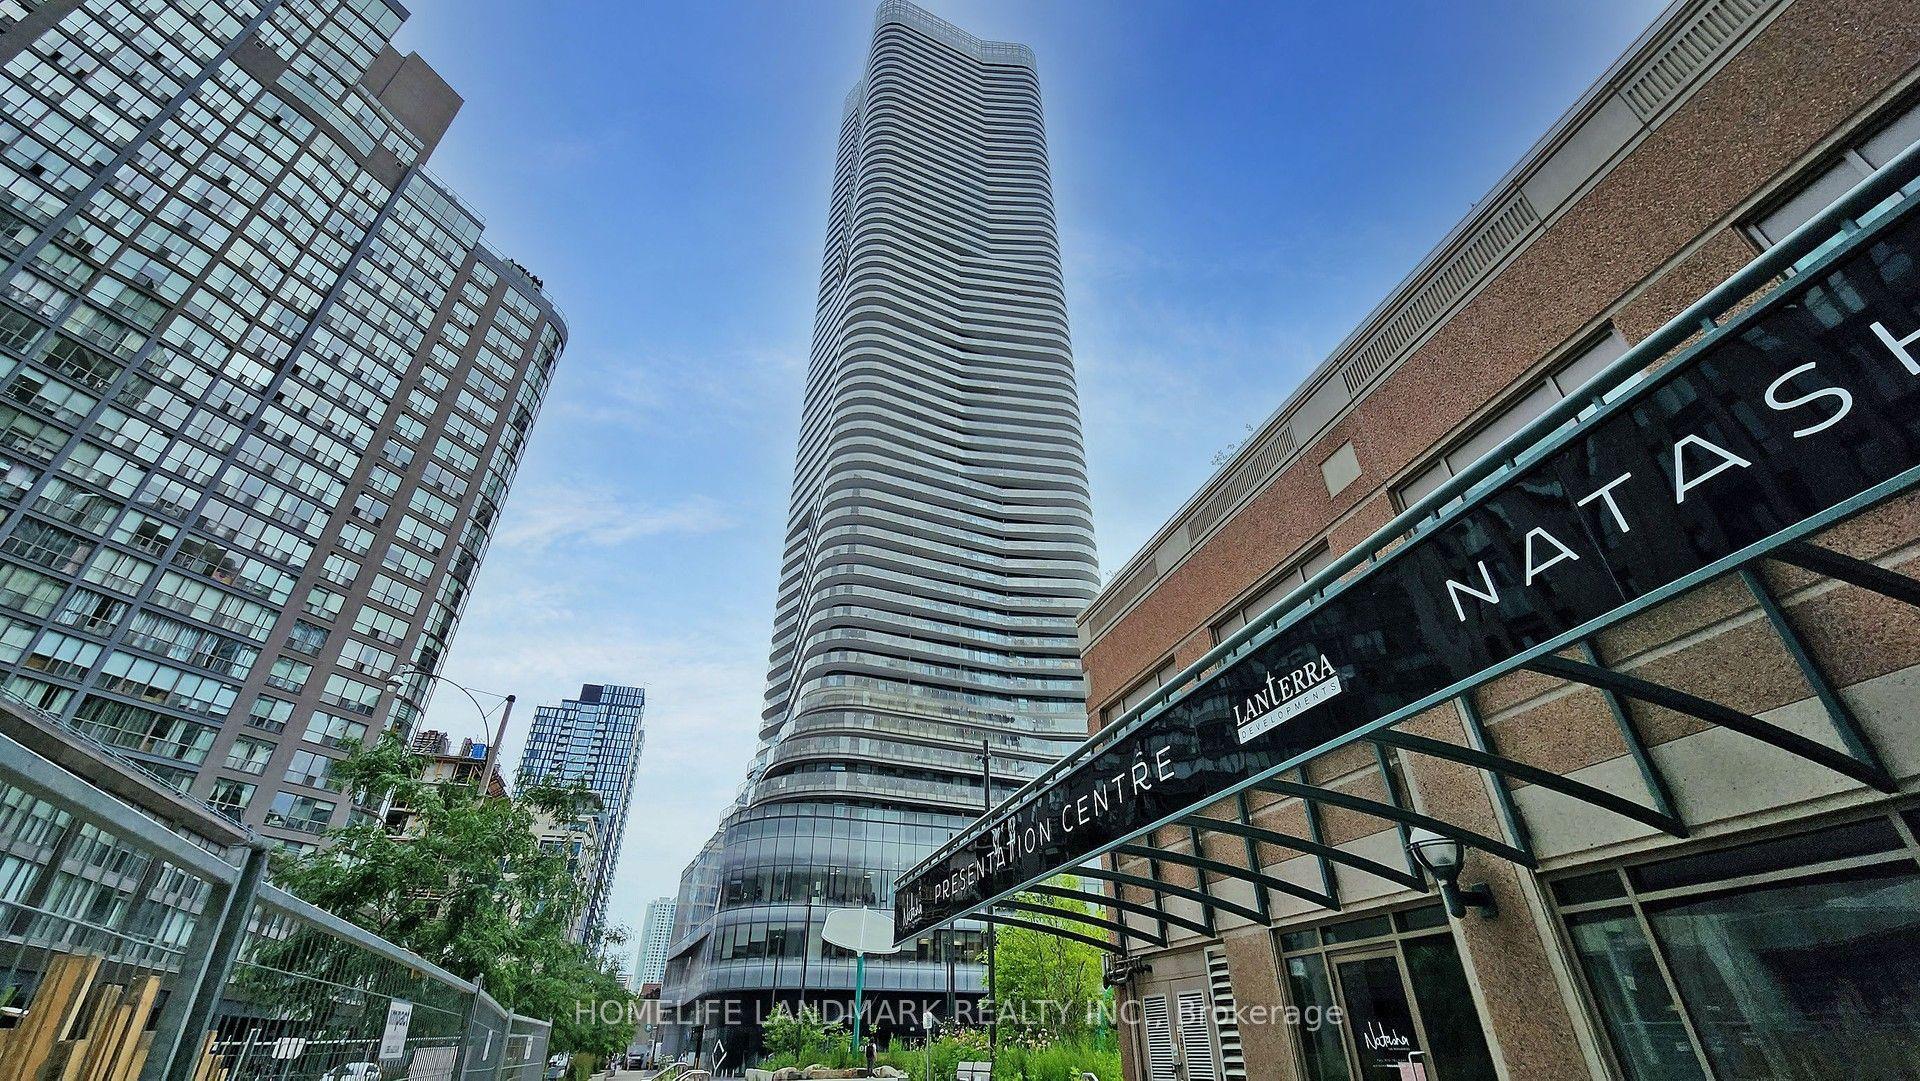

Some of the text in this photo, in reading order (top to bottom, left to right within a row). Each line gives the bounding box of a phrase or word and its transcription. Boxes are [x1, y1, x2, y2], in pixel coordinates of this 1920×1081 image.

[1241, 682, 1338, 739] DEVELOPMENTS
[934, 817, 1051, 904] PRESENTATION
[1062, 745, 1175, 832] CENTRE
[1363, 1021, 1410, 1050] Natasha
